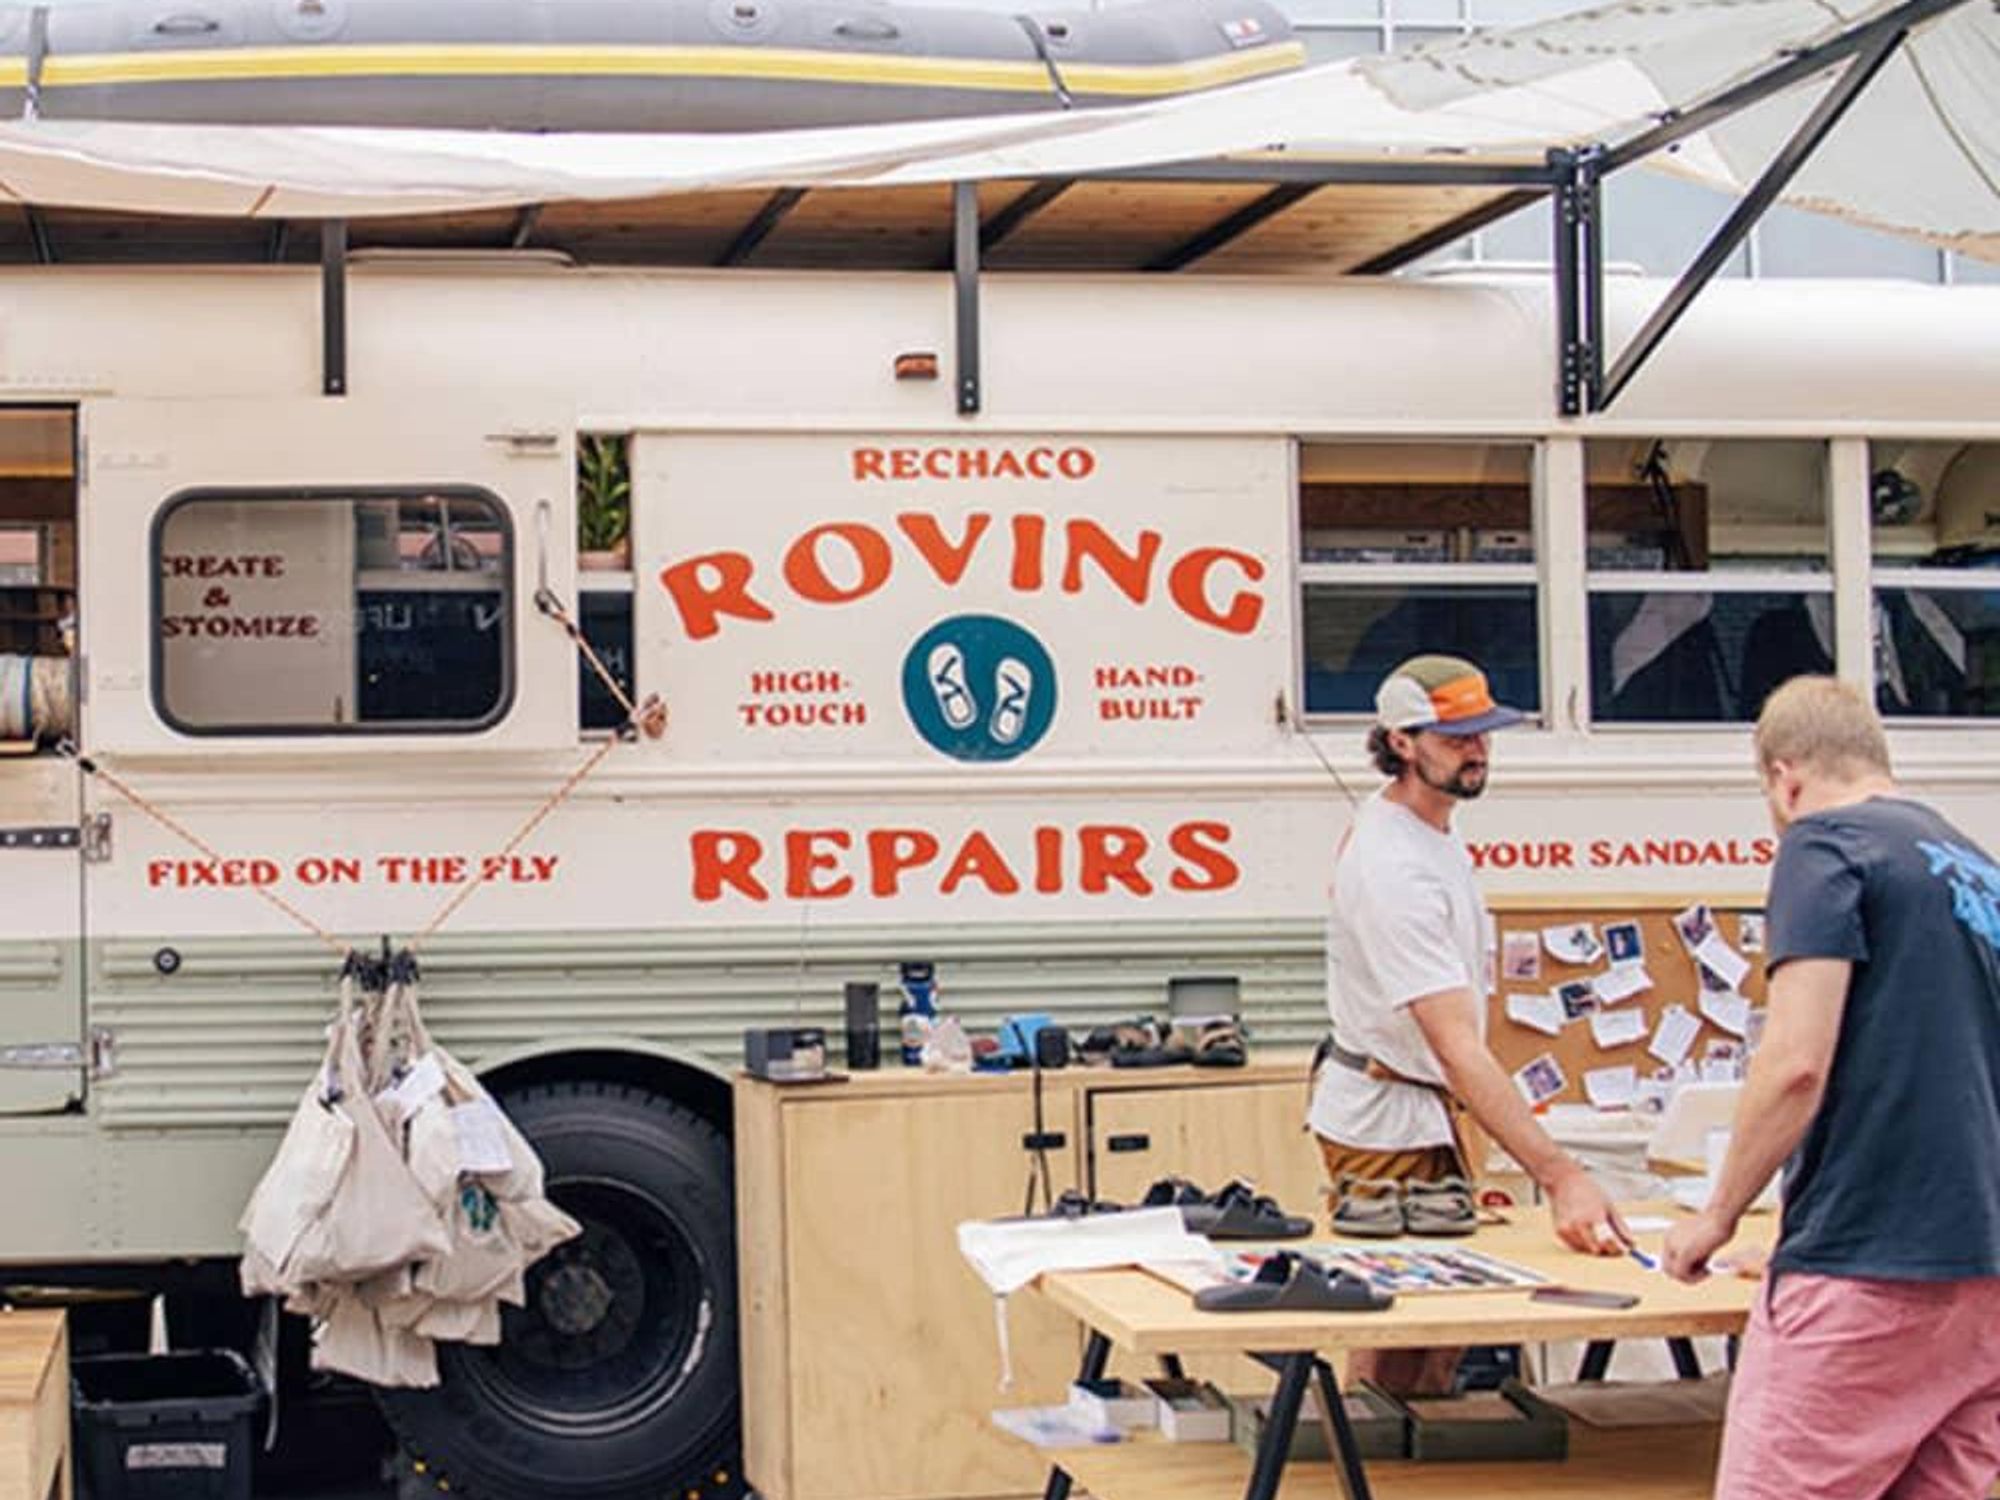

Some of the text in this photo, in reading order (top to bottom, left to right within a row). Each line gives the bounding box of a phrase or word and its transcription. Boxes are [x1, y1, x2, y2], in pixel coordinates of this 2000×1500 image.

[853, 448, 1095, 481] RECHACO
[661, 513, 1265, 640] ROVING
[203, 586, 230, 607] &
[751, 672, 850, 695] HIGH-
[1095, 665, 1204, 689] HAND-
[740, 703, 867, 727] TOUCH
[1100, 697, 1203, 721] BUILT
[690, 821, 1239, 902] REPAIRS
[1466, 838, 1775, 868] YOUR SANDALS
[148, 855, 558, 888] FIXED ON THE FLY
